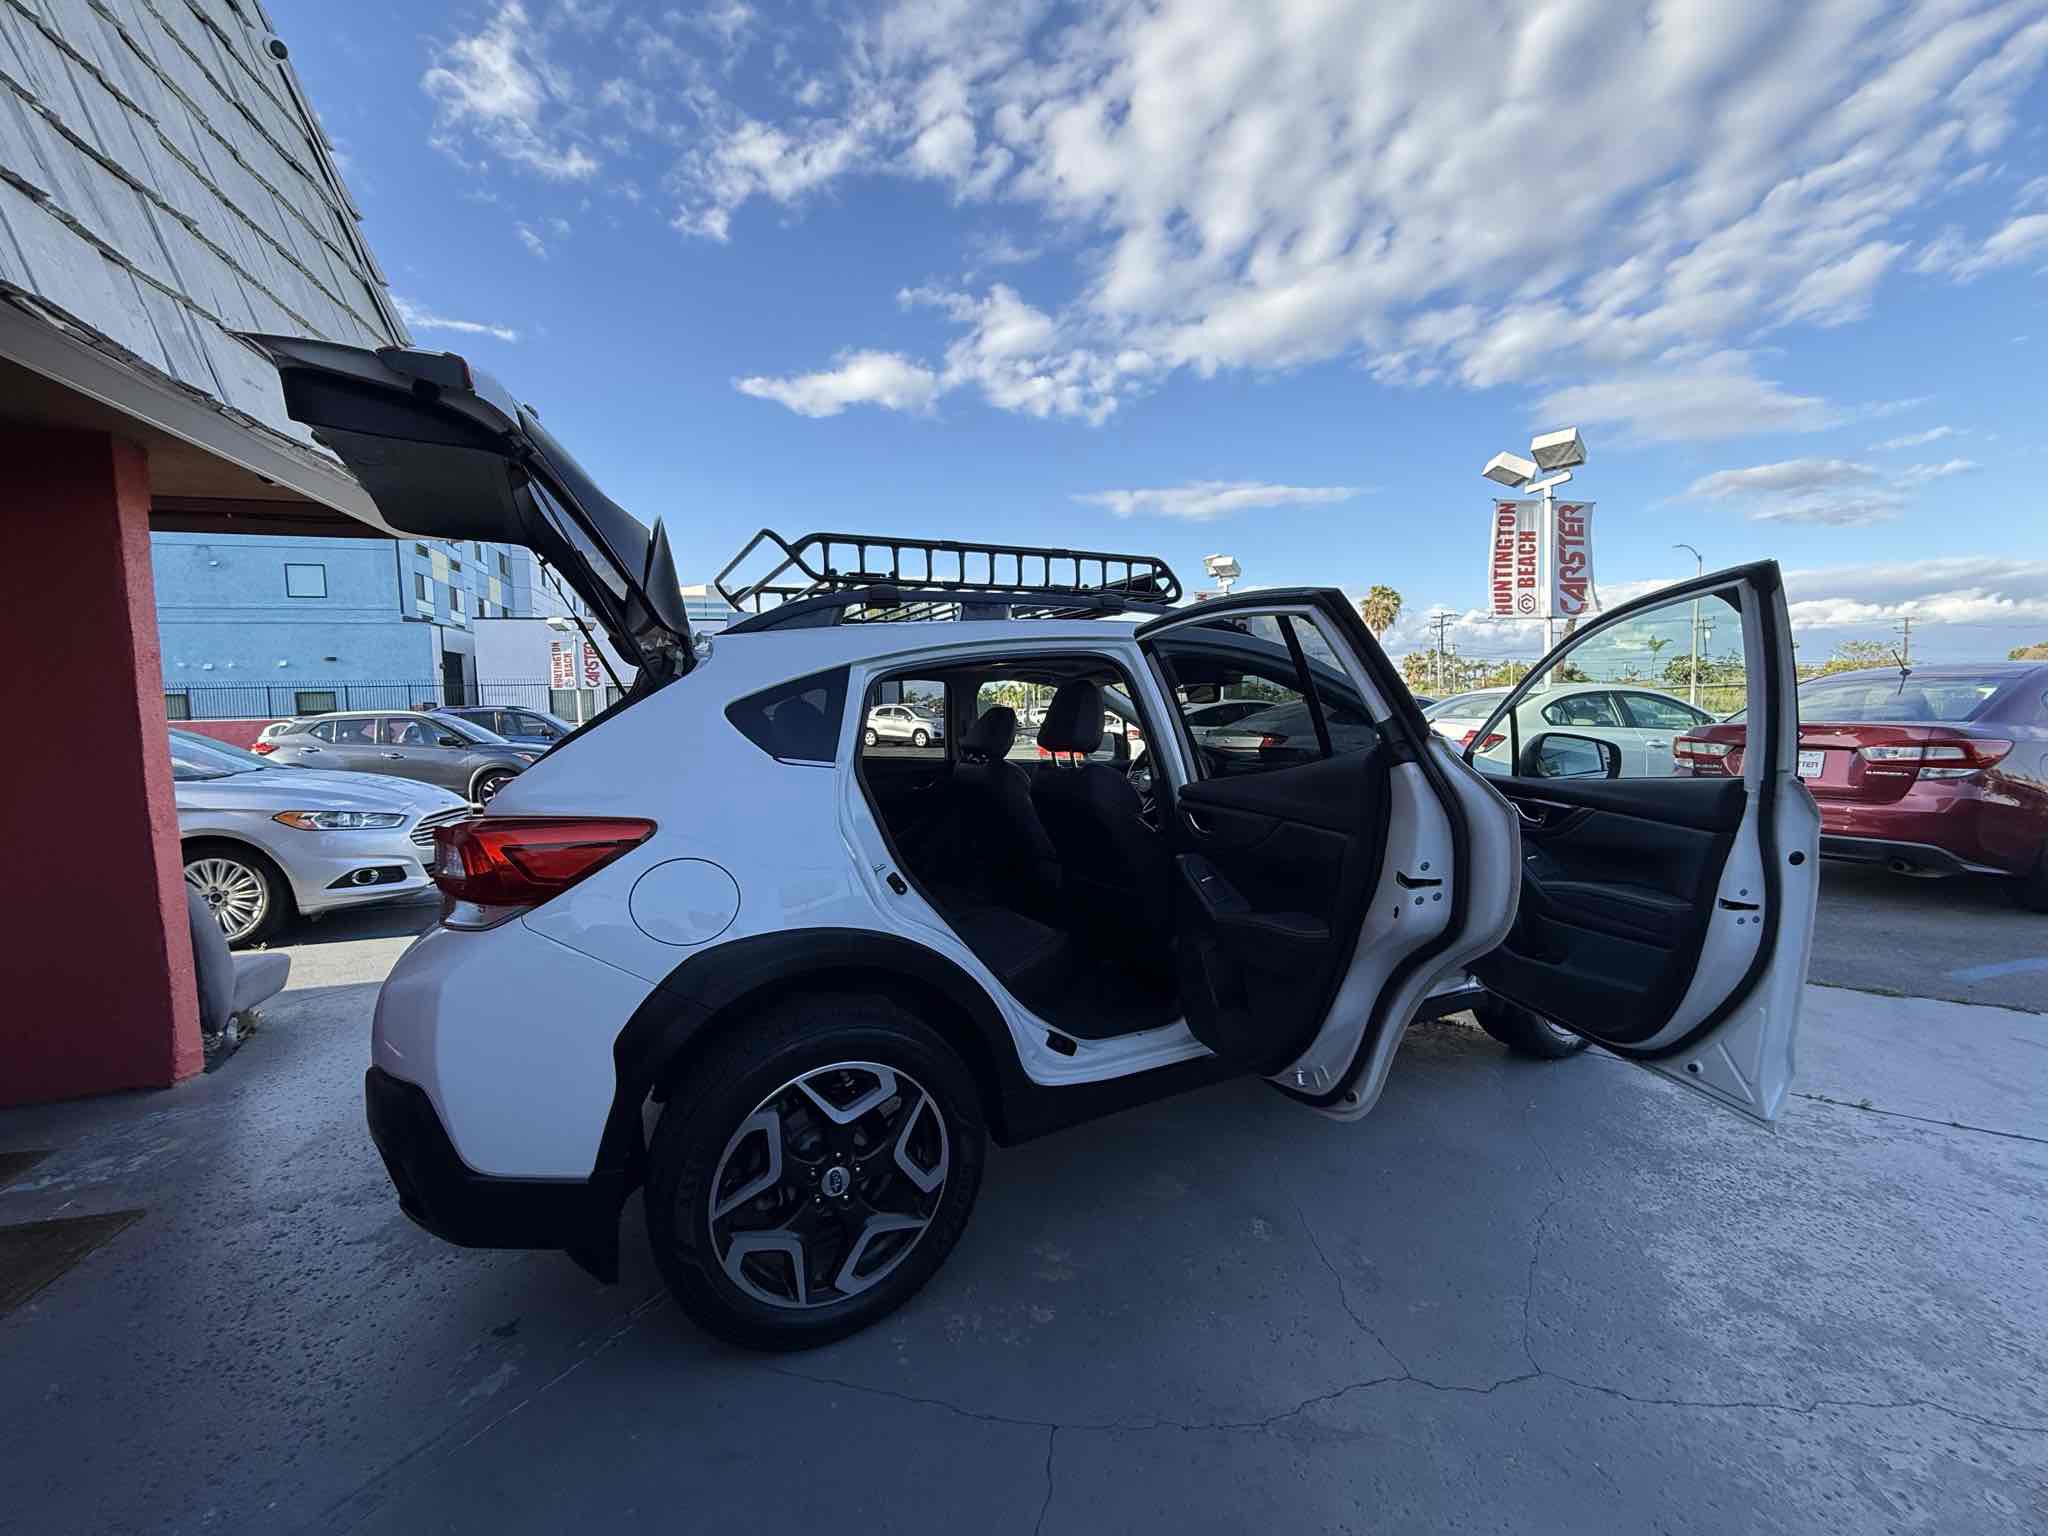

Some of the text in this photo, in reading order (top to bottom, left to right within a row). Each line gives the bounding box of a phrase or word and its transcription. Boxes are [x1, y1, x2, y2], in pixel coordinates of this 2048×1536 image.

[1493, 503, 1516, 615] HUNTINGTON
[1517, 531, 1536, 588] BEACH
[1558, 503, 1588, 615] CARSTER
[552, 642, 562, 688] HUNTINGTON
